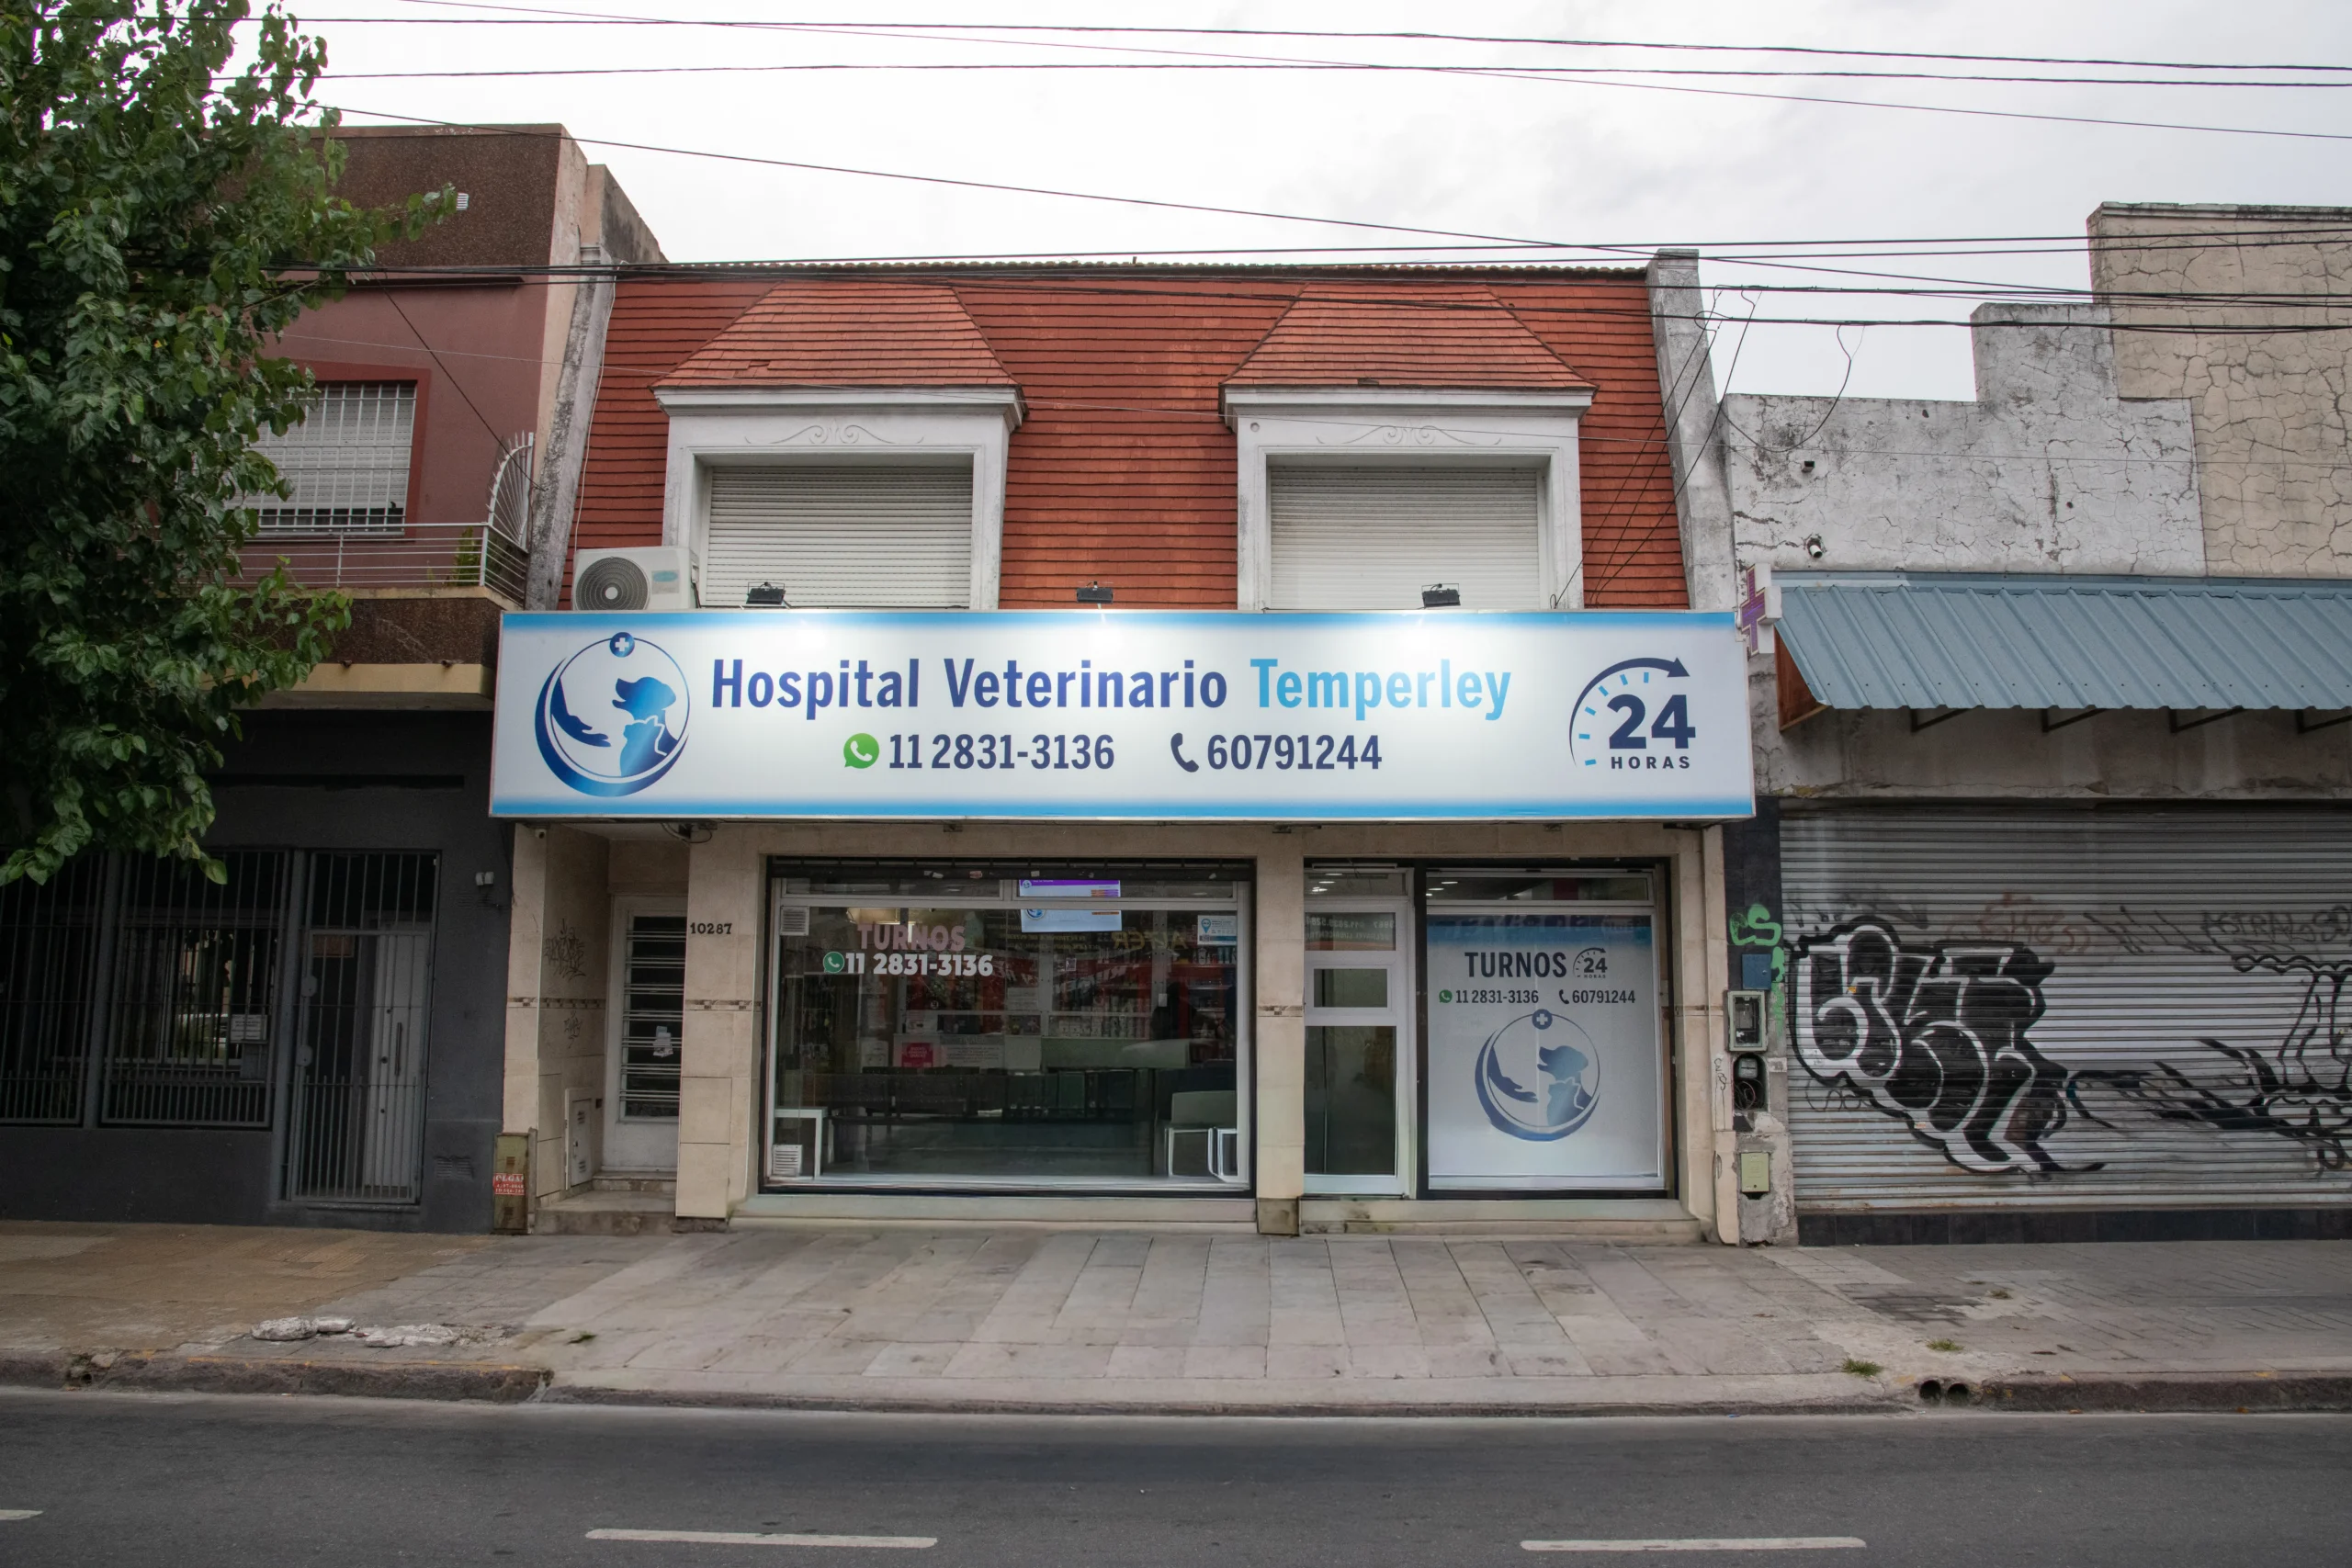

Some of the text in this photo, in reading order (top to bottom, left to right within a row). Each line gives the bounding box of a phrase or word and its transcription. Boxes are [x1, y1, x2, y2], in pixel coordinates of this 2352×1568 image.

[712, 658, 1512, 721] Hospital Veterinario Temperley
[1608, 694, 1697, 750] 24
[888, 733, 1114, 770] 11 2831-3136
[1207, 734, 1383, 771] 60791244
[1611, 755, 1690, 770] HORAS
[690, 921, 732, 935] 10287
[857, 923, 966, 953] TURNOS
[845, 952, 994, 977] 11 2831-3136
[1464, 952, 1567, 978] TURNOS
[1583, 957, 1608, 973] 24
[1455, 989, 1539, 1004] 11 2831-3136
[1572, 989, 1636, 1004] 60791244
